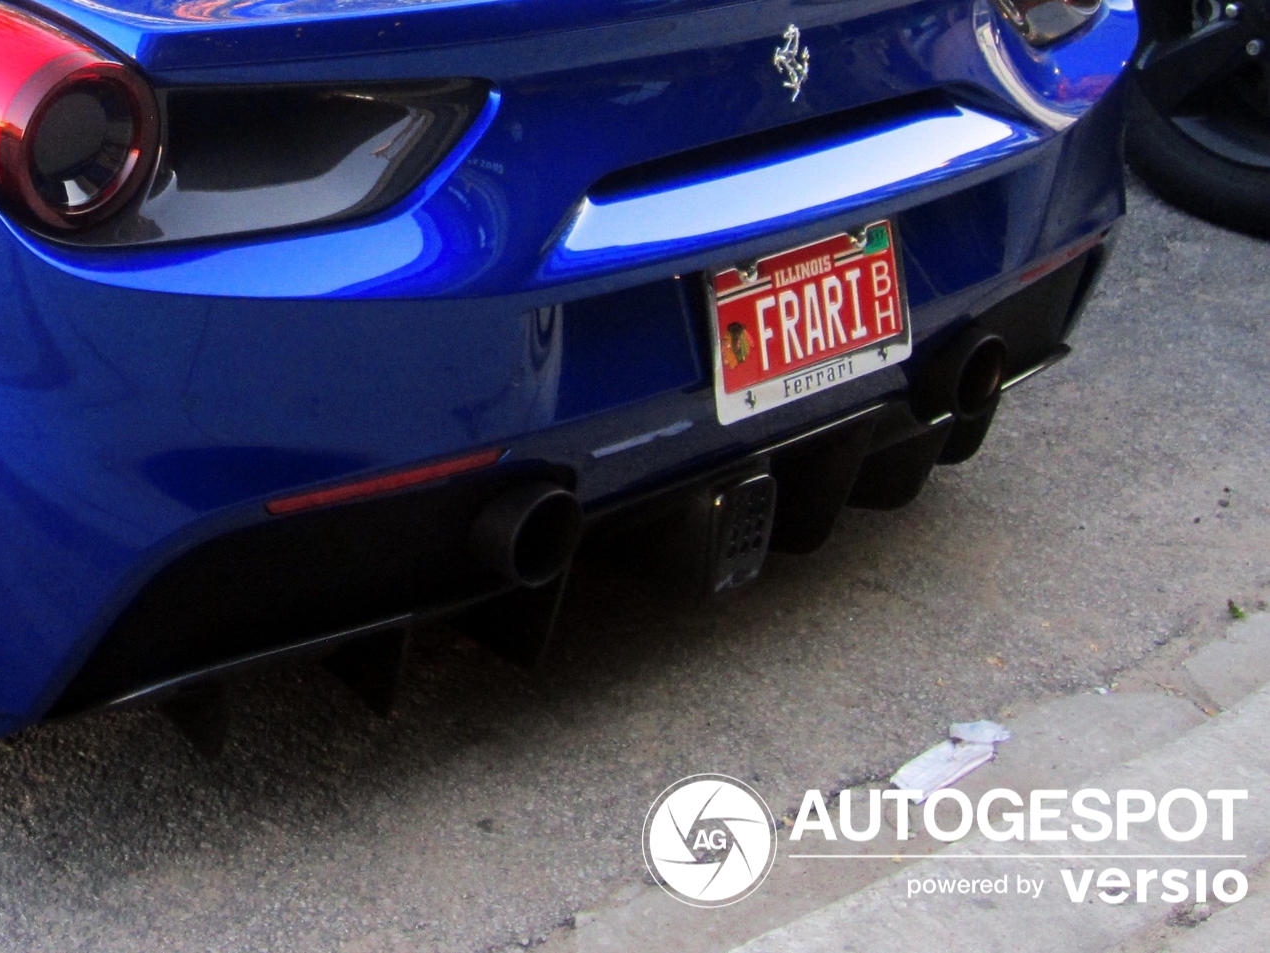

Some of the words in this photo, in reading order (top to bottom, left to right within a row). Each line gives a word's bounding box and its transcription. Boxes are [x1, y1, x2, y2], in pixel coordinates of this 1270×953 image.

[773, 255, 832, 288] ILLINOIS
[755, 268, 867, 371] FRARI
[783, 356, 854, 398] Ferrari
